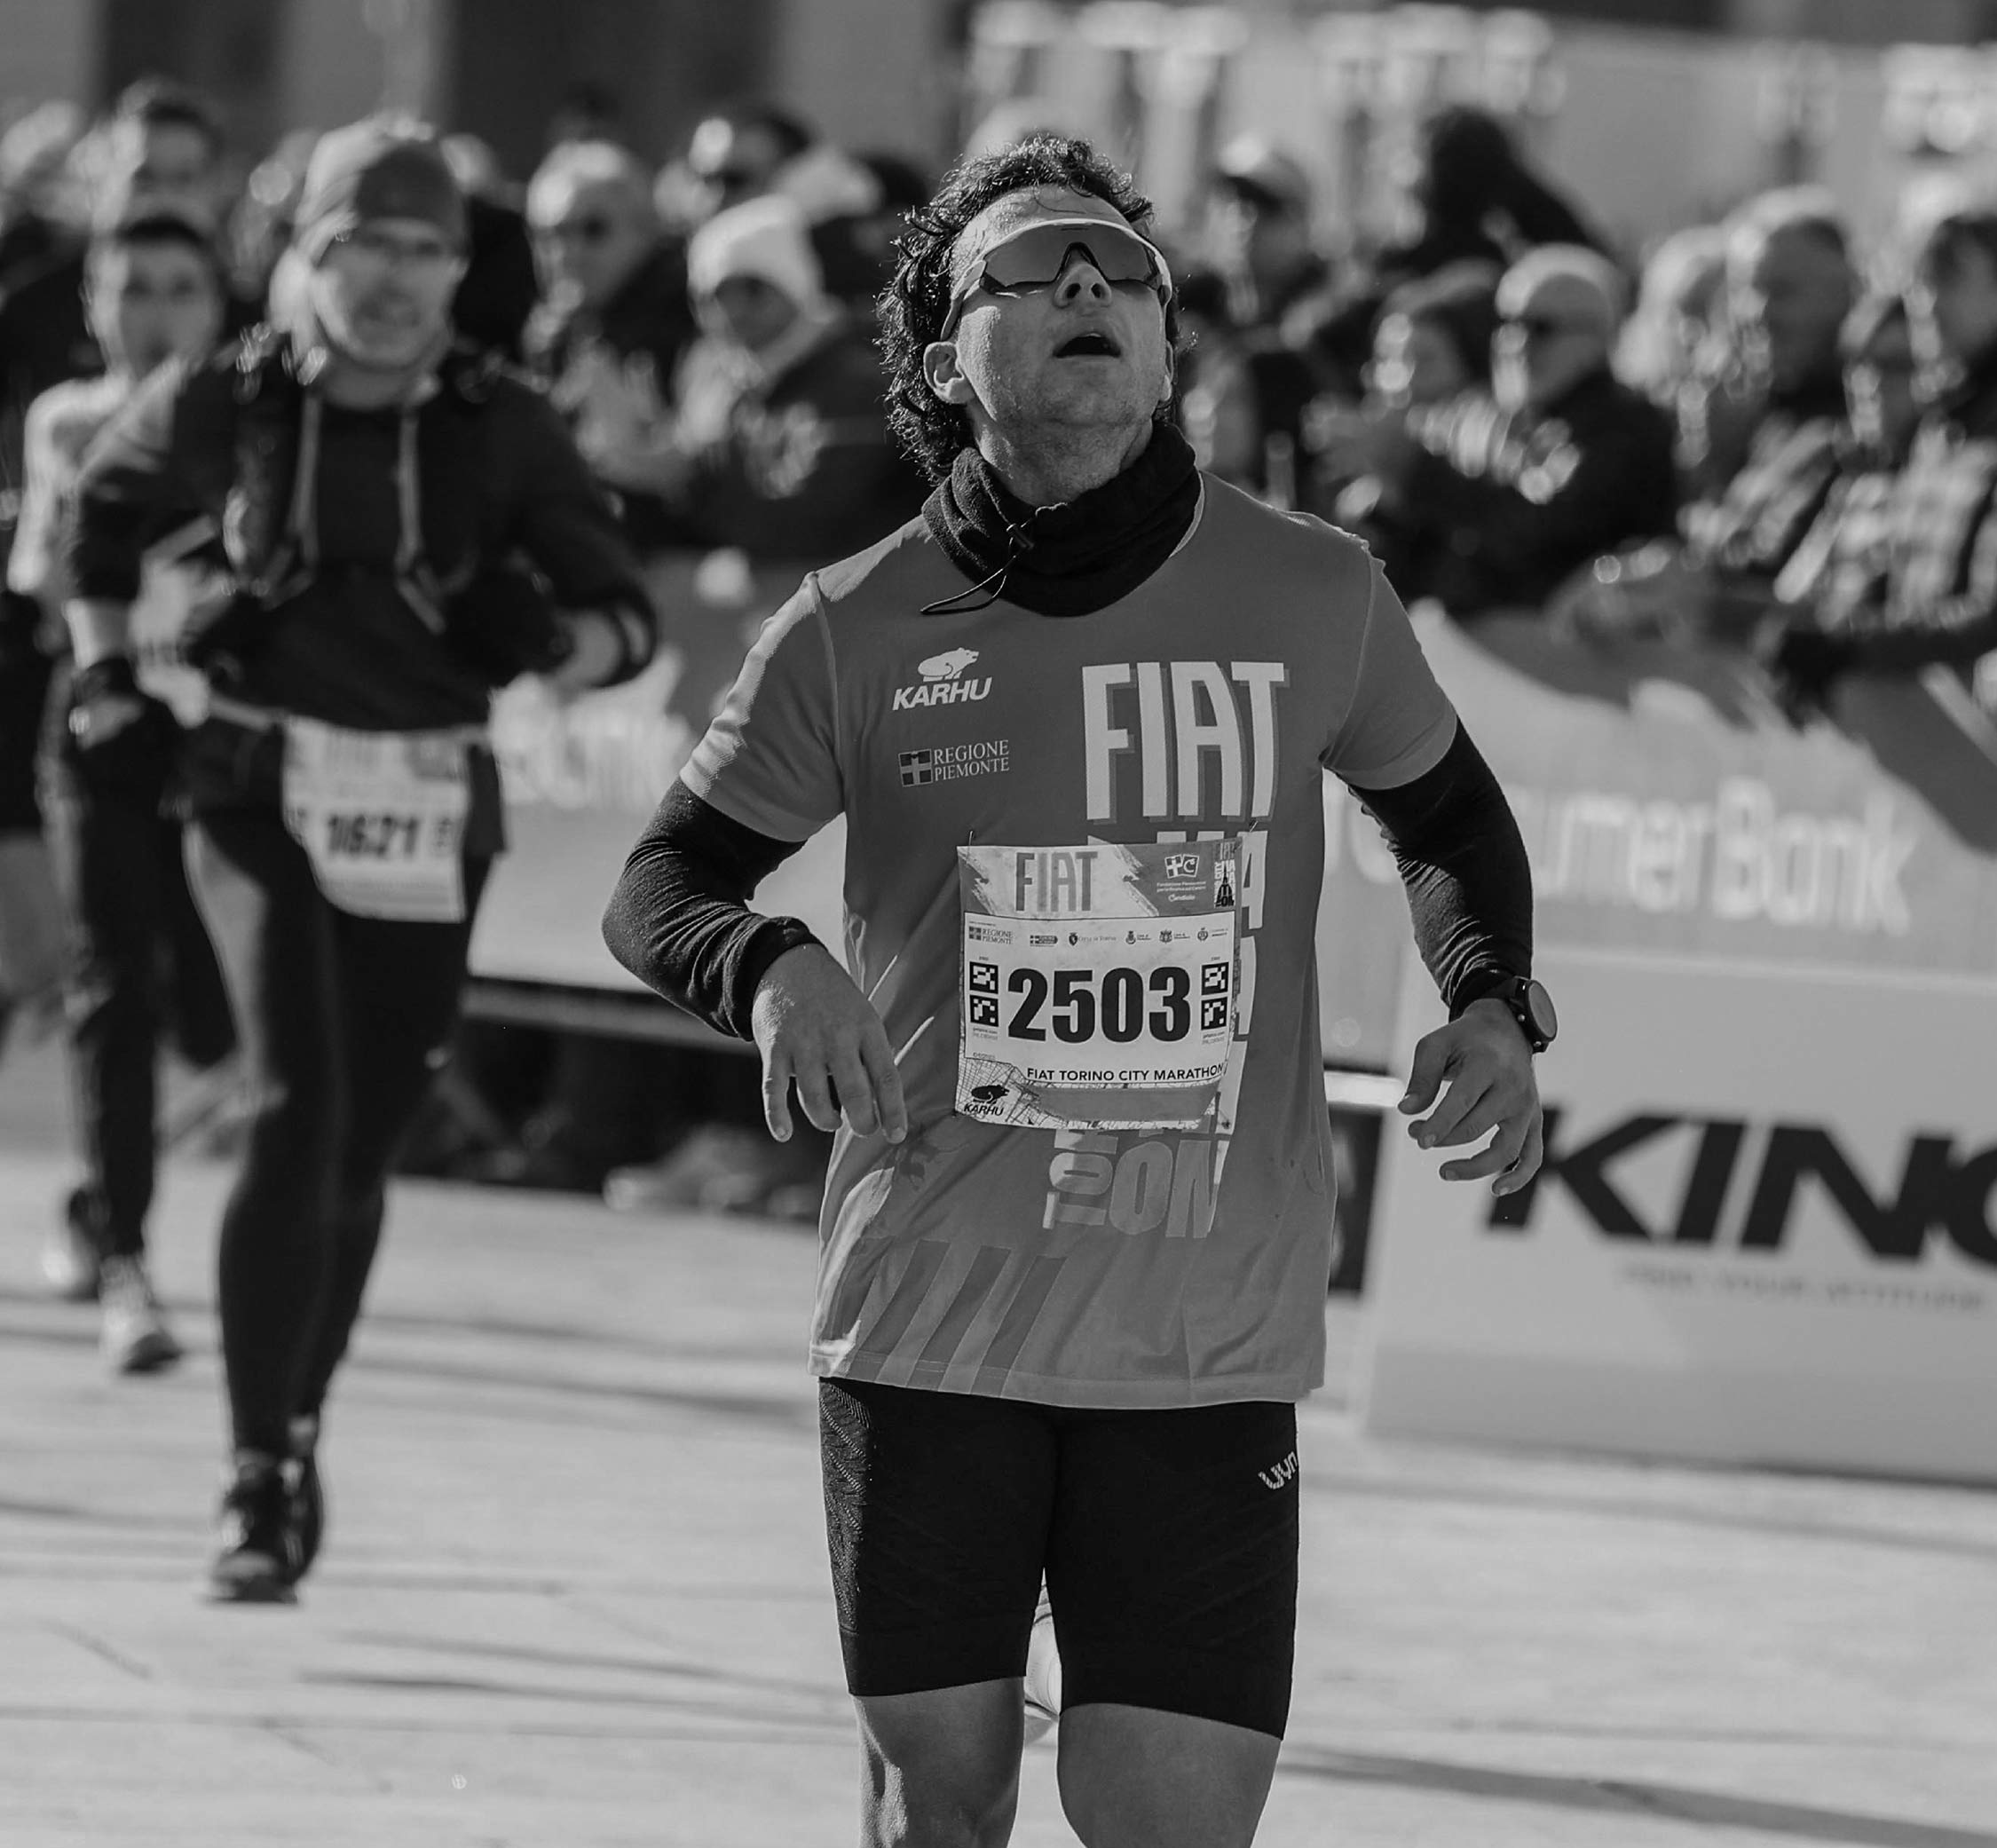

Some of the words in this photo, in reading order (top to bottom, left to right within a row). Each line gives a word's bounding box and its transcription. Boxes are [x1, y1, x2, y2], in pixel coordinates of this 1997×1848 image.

[892, 676, 992, 711] KARHU
[934, 739, 1009, 765] REGIONE
[1082, 661, 1287, 822] FIAT
[935, 757, 1010, 781] PIEMONTE
[1015, 851, 1098, 912] FIAT
[1007, 966, 1191, 1044] 2503
[1027, 1068, 1055, 1080] FIAT
[1059, 1070, 1114, 1081] TORINO
[1118, 1070, 1149, 1081] CITY
[1154, 1062, 1224, 1081] MARATHON
[963, 1102, 1005, 1117] KARHU
[1109, 1140, 1231, 1239] ON
